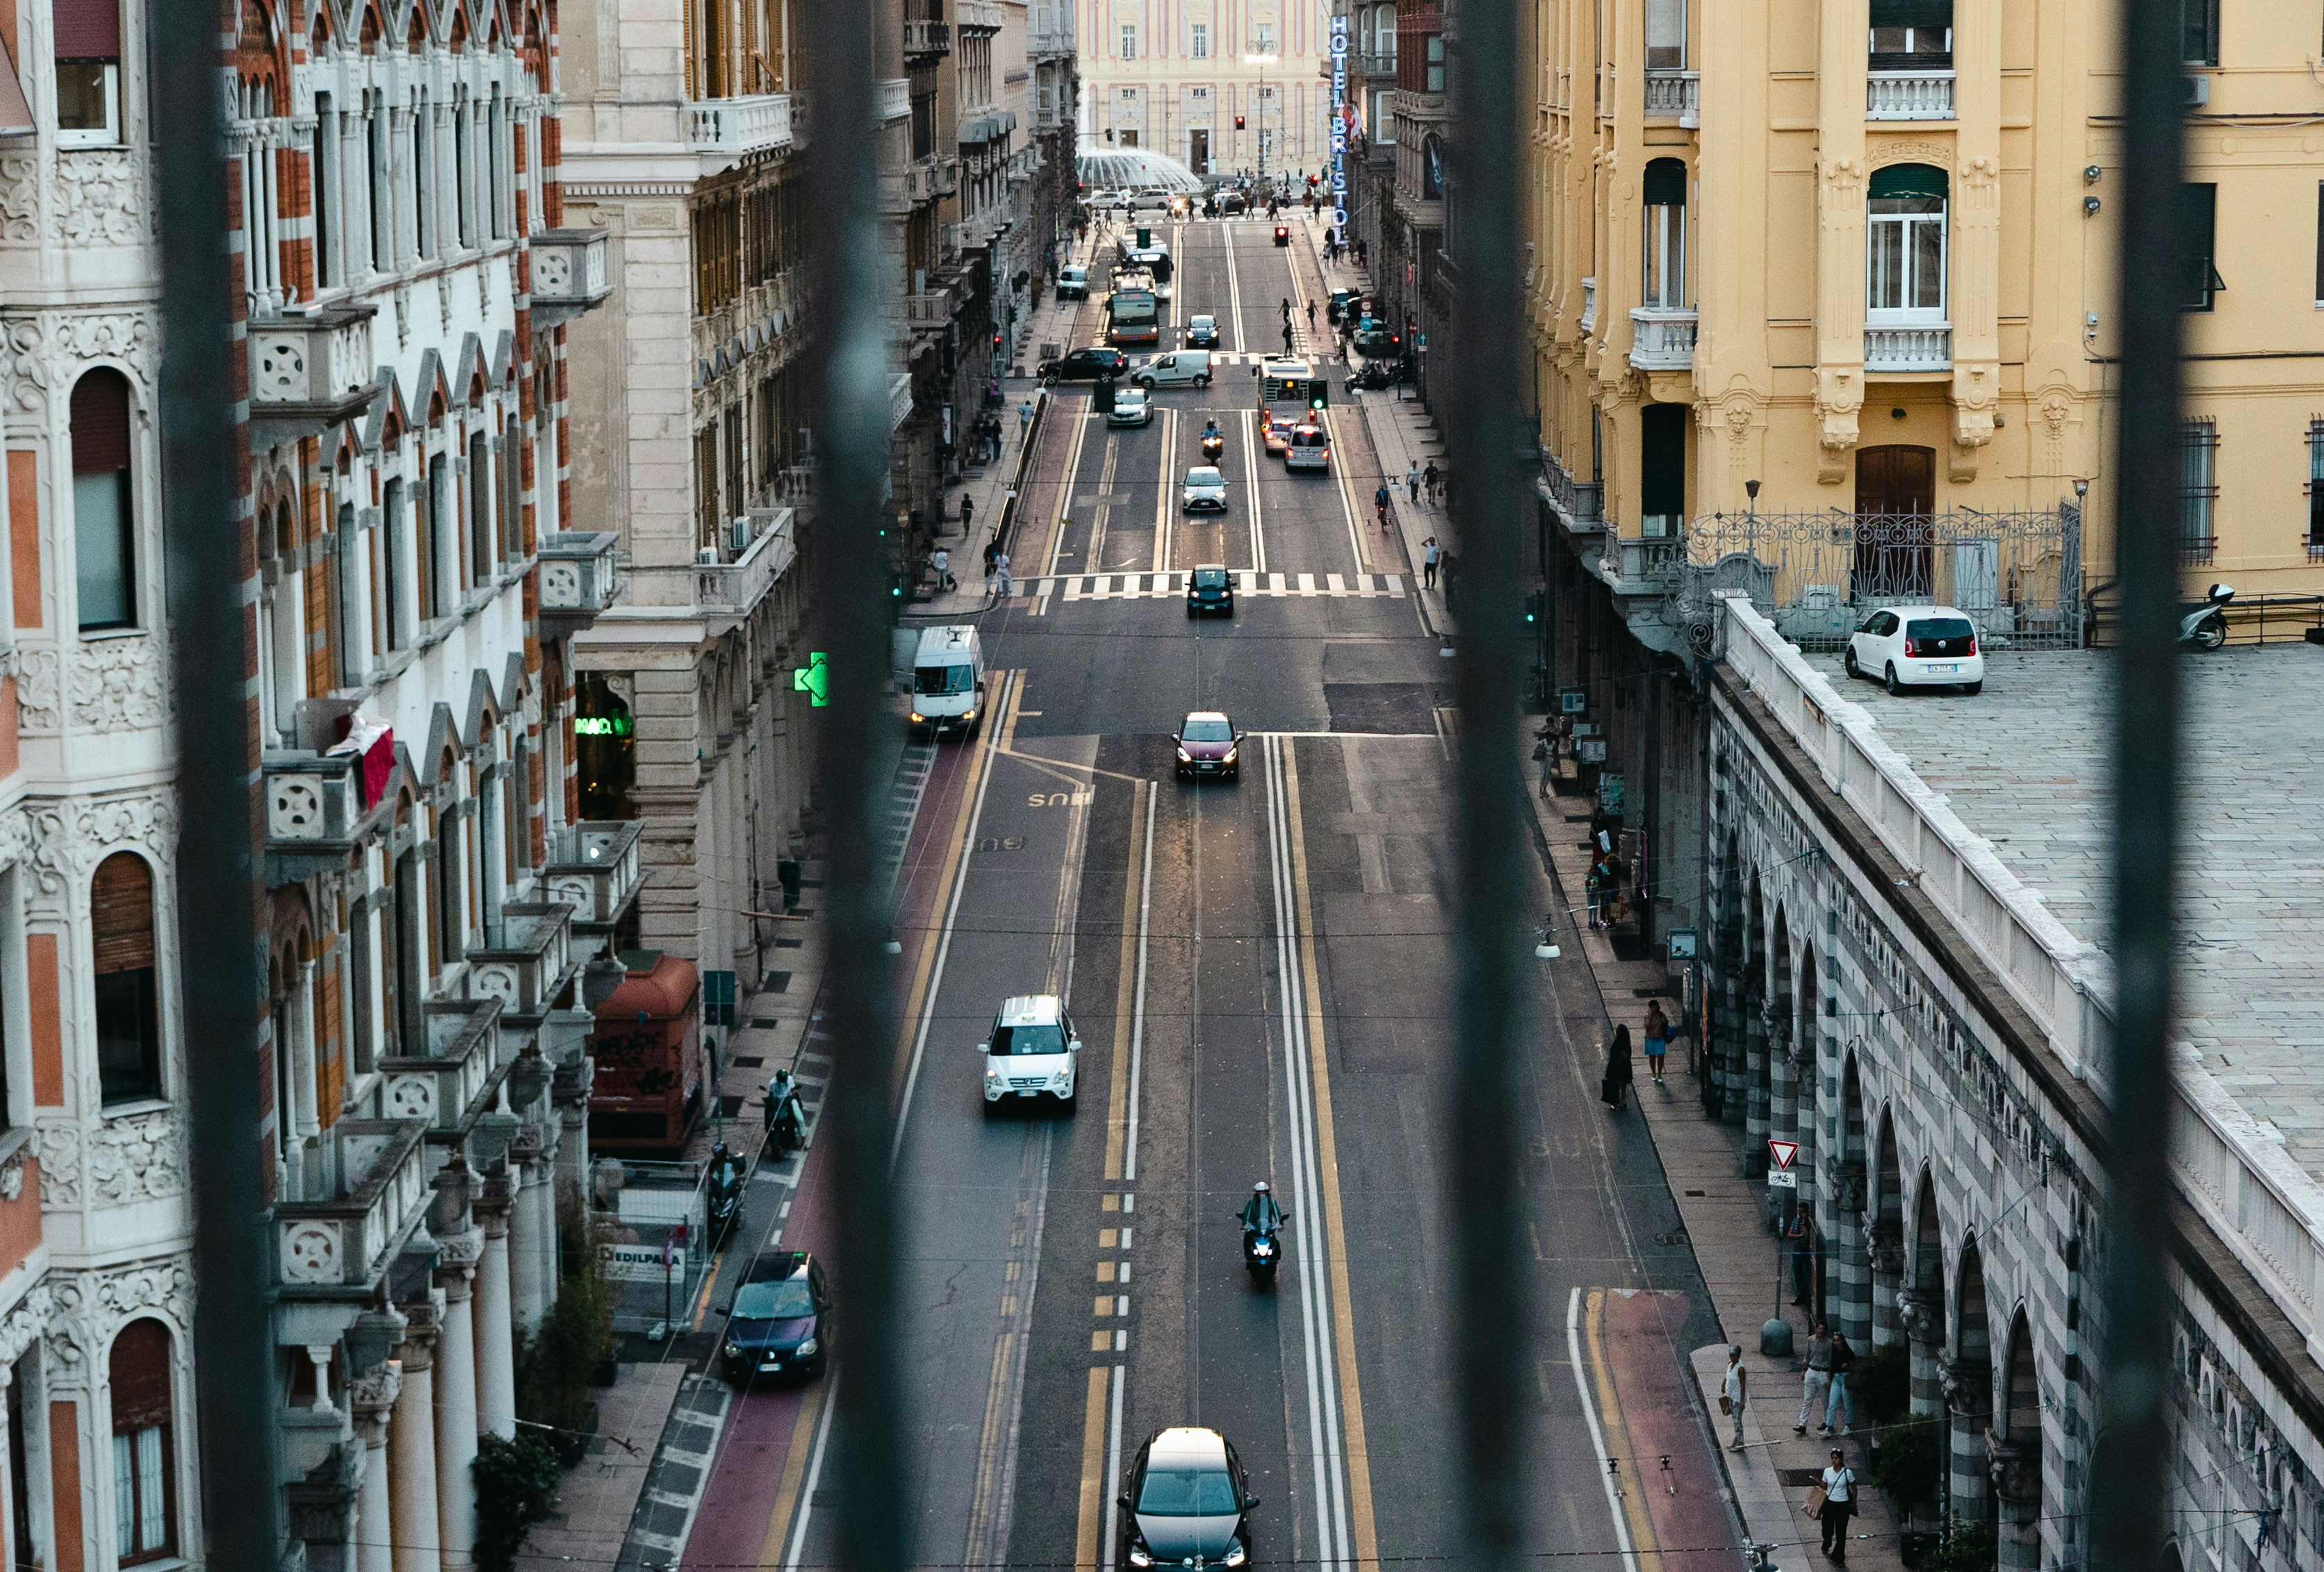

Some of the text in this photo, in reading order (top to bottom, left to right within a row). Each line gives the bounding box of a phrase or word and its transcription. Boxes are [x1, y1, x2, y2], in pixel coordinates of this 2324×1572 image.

[1331, 16, 1348, 245] HOTEL BRISTOL
[616, 1252, 680, 1265] EDILPAA
